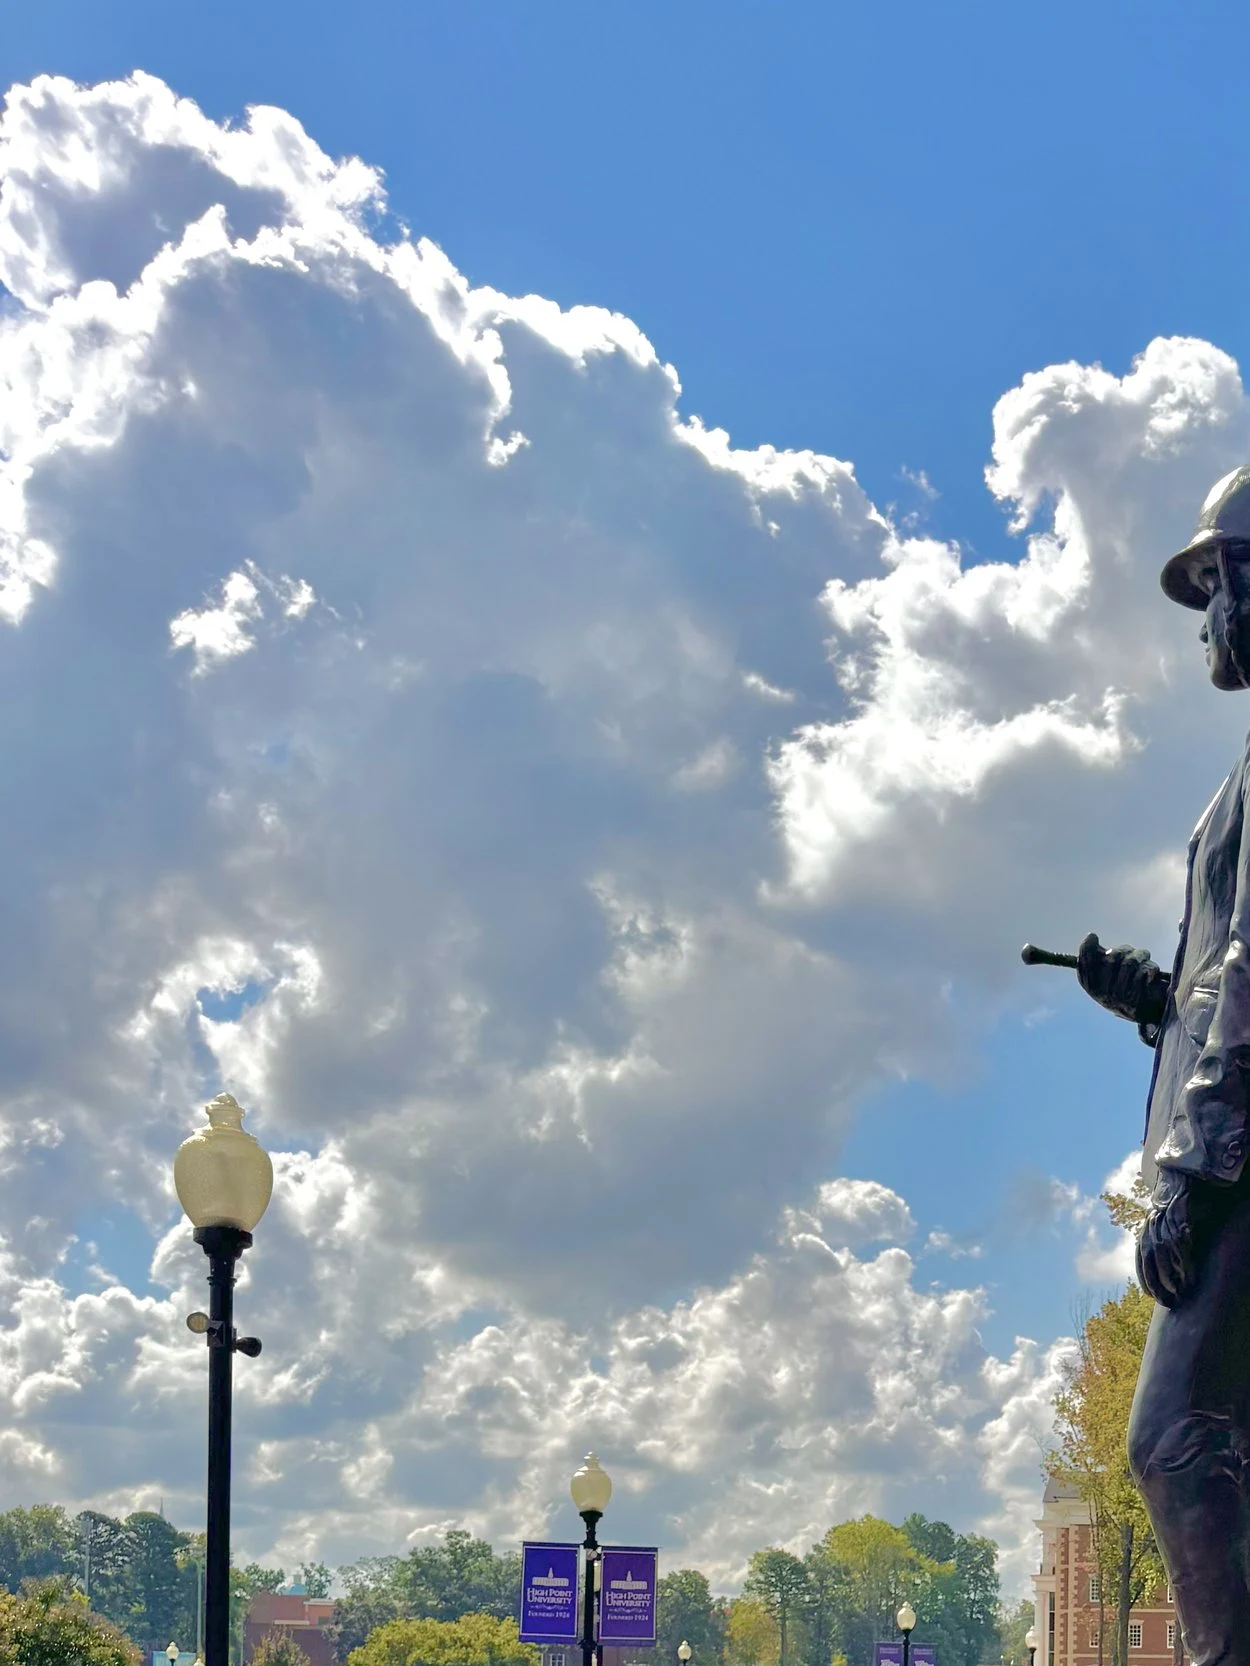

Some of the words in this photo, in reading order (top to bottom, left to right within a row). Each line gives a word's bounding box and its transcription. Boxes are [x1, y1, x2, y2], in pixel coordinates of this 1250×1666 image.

[527, 1587, 548, 1596] HIGH
[549, 1588, 573, 1597] POINT
[606, 1591, 627, 1600] HIGH
[627, 1592, 651, 1601] POINT
[527, 1595, 572, 1604] UNIVERSITY
[606, 1599, 651, 1607] UNIVERSITY
